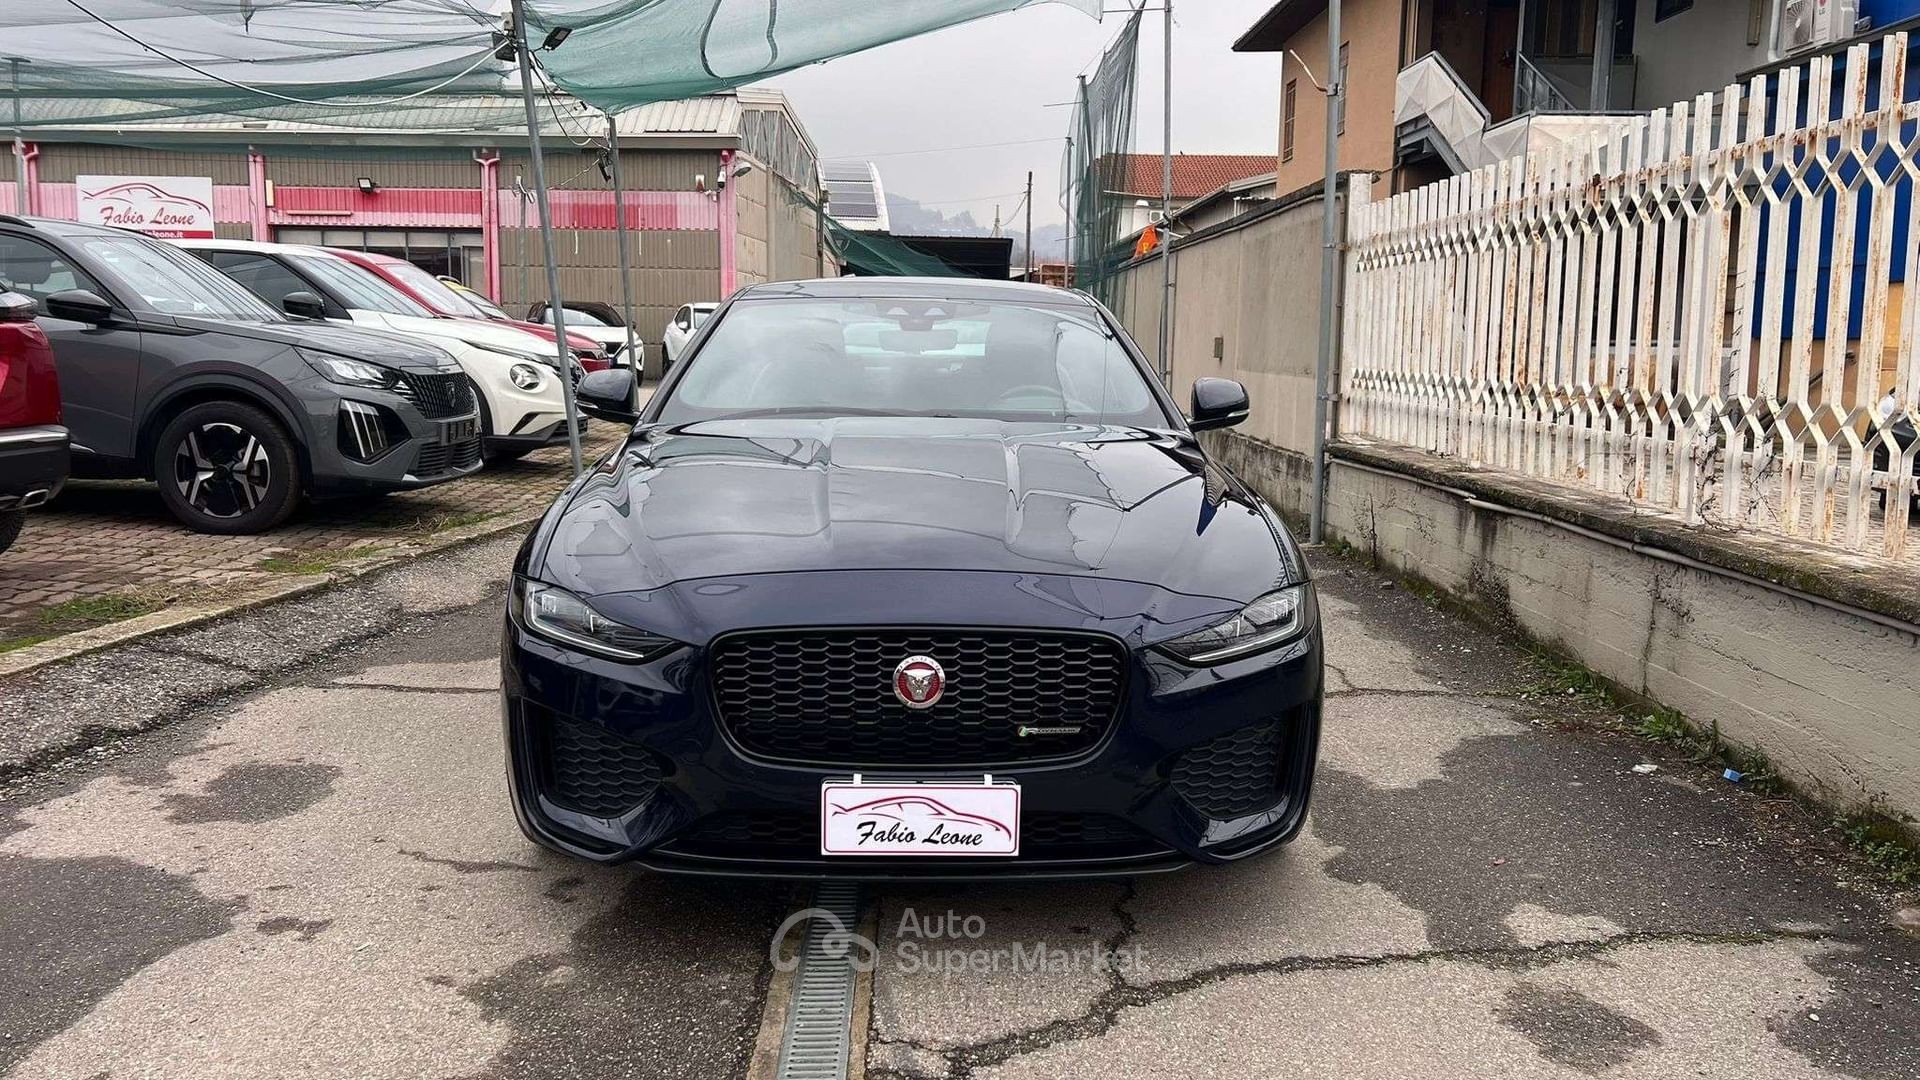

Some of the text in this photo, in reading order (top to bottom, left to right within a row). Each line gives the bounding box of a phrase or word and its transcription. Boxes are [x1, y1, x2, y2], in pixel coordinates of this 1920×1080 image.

[100, 206, 195, 226] Fabio Leone
[857, 821, 983, 846] Fabio Leone
